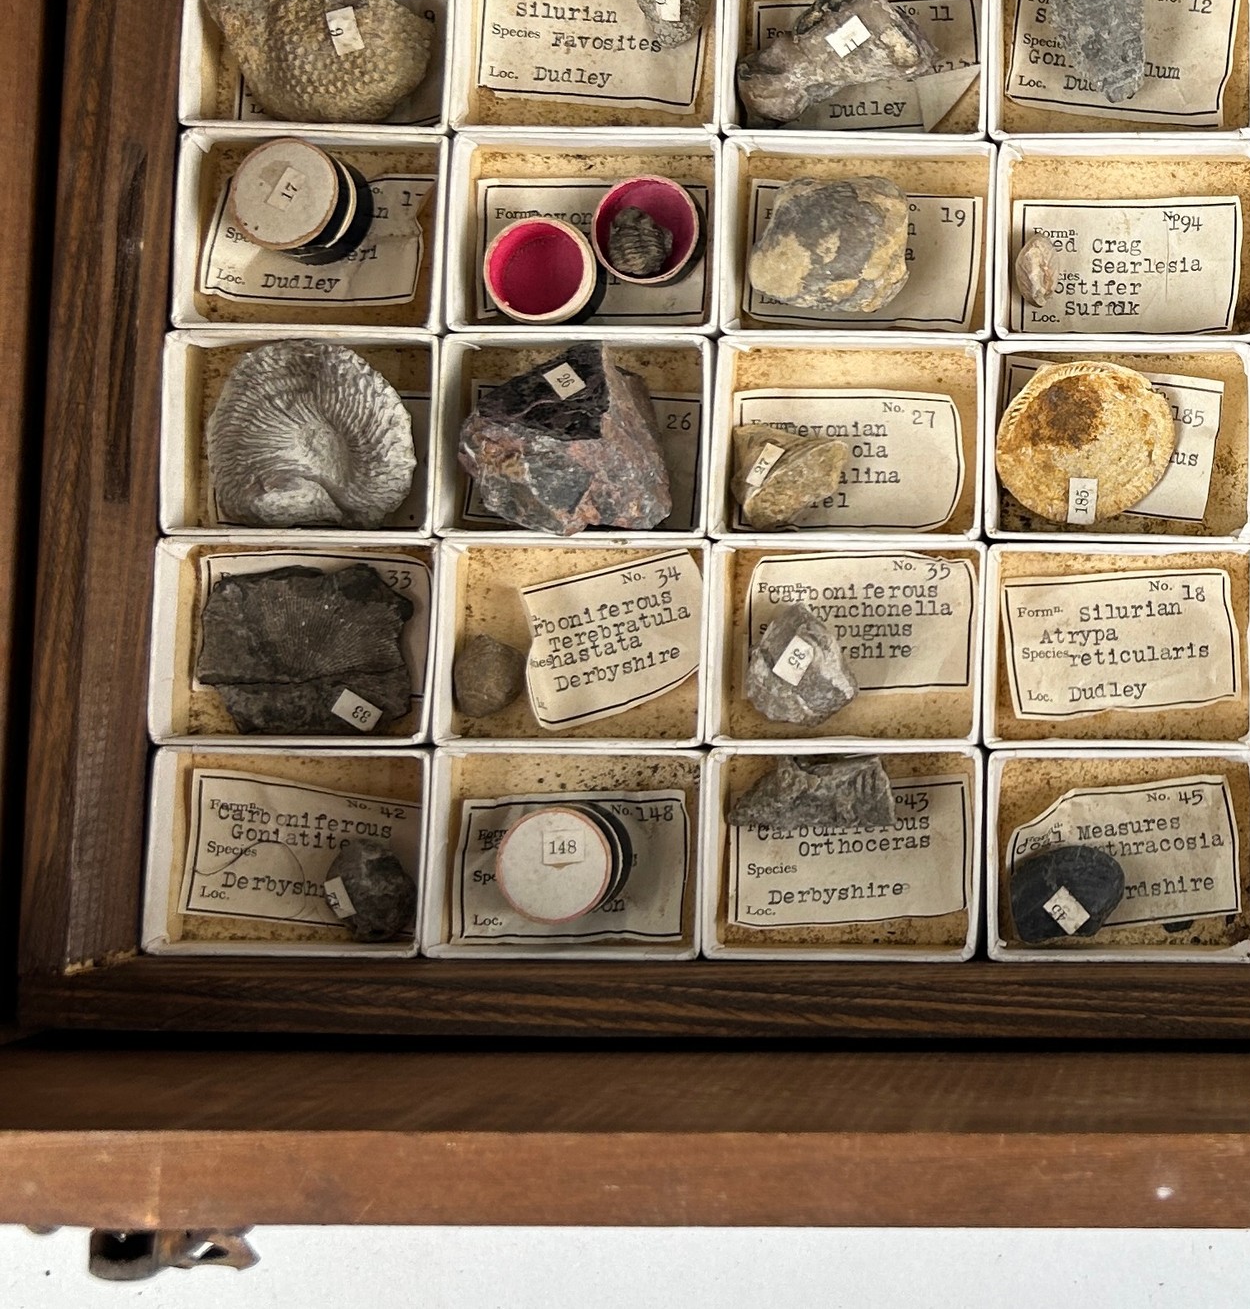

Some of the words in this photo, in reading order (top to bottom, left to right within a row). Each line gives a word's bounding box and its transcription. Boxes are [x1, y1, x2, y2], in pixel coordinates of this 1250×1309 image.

[515, 1, 618, 24] Silurian
[929, 5, 955, 22] 11
[492, 24, 541, 40] Species
[551, 31, 662, 53] Favosites
[489, 65, 519, 80] Loc.
[533, 66, 613, 88] Dudley
[1018, 75, 1047, 89] Loc.
[829, 100, 907, 119] Dudley
[281, 182, 299, 202] 17
[941, 206, 967, 228] 19
[1052, 237, 1078, 253] ed
[1092, 238, 1142, 256] Crag
[1092, 258, 1203, 275] Searlesia
[215, 267, 246, 285] Loc.
[261, 273, 342, 292] Dudley
[1053, 280, 1142, 296] ostifer
[1031, 312, 1061, 323] Loc.
[556, 372, 575, 389] 26
[666, 412, 692, 432] 26
[882, 402, 906, 414] No.
[912, 410, 937, 429] 27
[1172, 405, 1206, 428] 185
[753, 458, 770, 476] 27
[1075, 490, 1090, 515] 185
[386, 569, 412, 589] 33
[621, 571, 646, 585] No.
[655, 565, 682, 589] 34
[892, 559, 917, 572] No.
[925, 562, 951, 581] 35
[769, 583, 938, 604] Carboniferous
[1149, 580, 1174, 592] No.
[1182, 584, 1206, 602] 18
[809, 600, 953, 622] hynchonella
[1079, 600, 1183, 623] Silurian
[549, 605, 692, 653] Terebratula
[835, 623, 913, 640] pugnus
[1040, 626, 1119, 646] Atrypa
[549, 635, 643, 669] hastata
[1022, 647, 1068, 662] Species
[1069, 642, 1210, 668] reticularis
[553, 646, 681, 693] Derbyshire
[1028, 690, 1053, 703] Loc.
[1069, 681, 1148, 703] Dudley
[351, 704, 372, 723] 33
[904, 792, 930, 813] 43
[1146, 791, 1171, 802] No.
[1178, 789, 1204, 805] 45
[217, 807, 393, 839] Carboniferous
[380, 807, 407, 820] 42
[635, 804, 675, 822] 148
[1077, 815, 1182, 841] Measures
[207, 840, 258, 857] Species
[549, 839, 578, 856] 148
[798, 833, 931, 857] Orthoceras
[747, 863, 798, 879] Species
[200, 885, 230, 900] Loc.
[768, 881, 905, 905] Derbyshire
[473, 914, 503, 927] Loc.
[746, 905, 776, 917] Loc.
